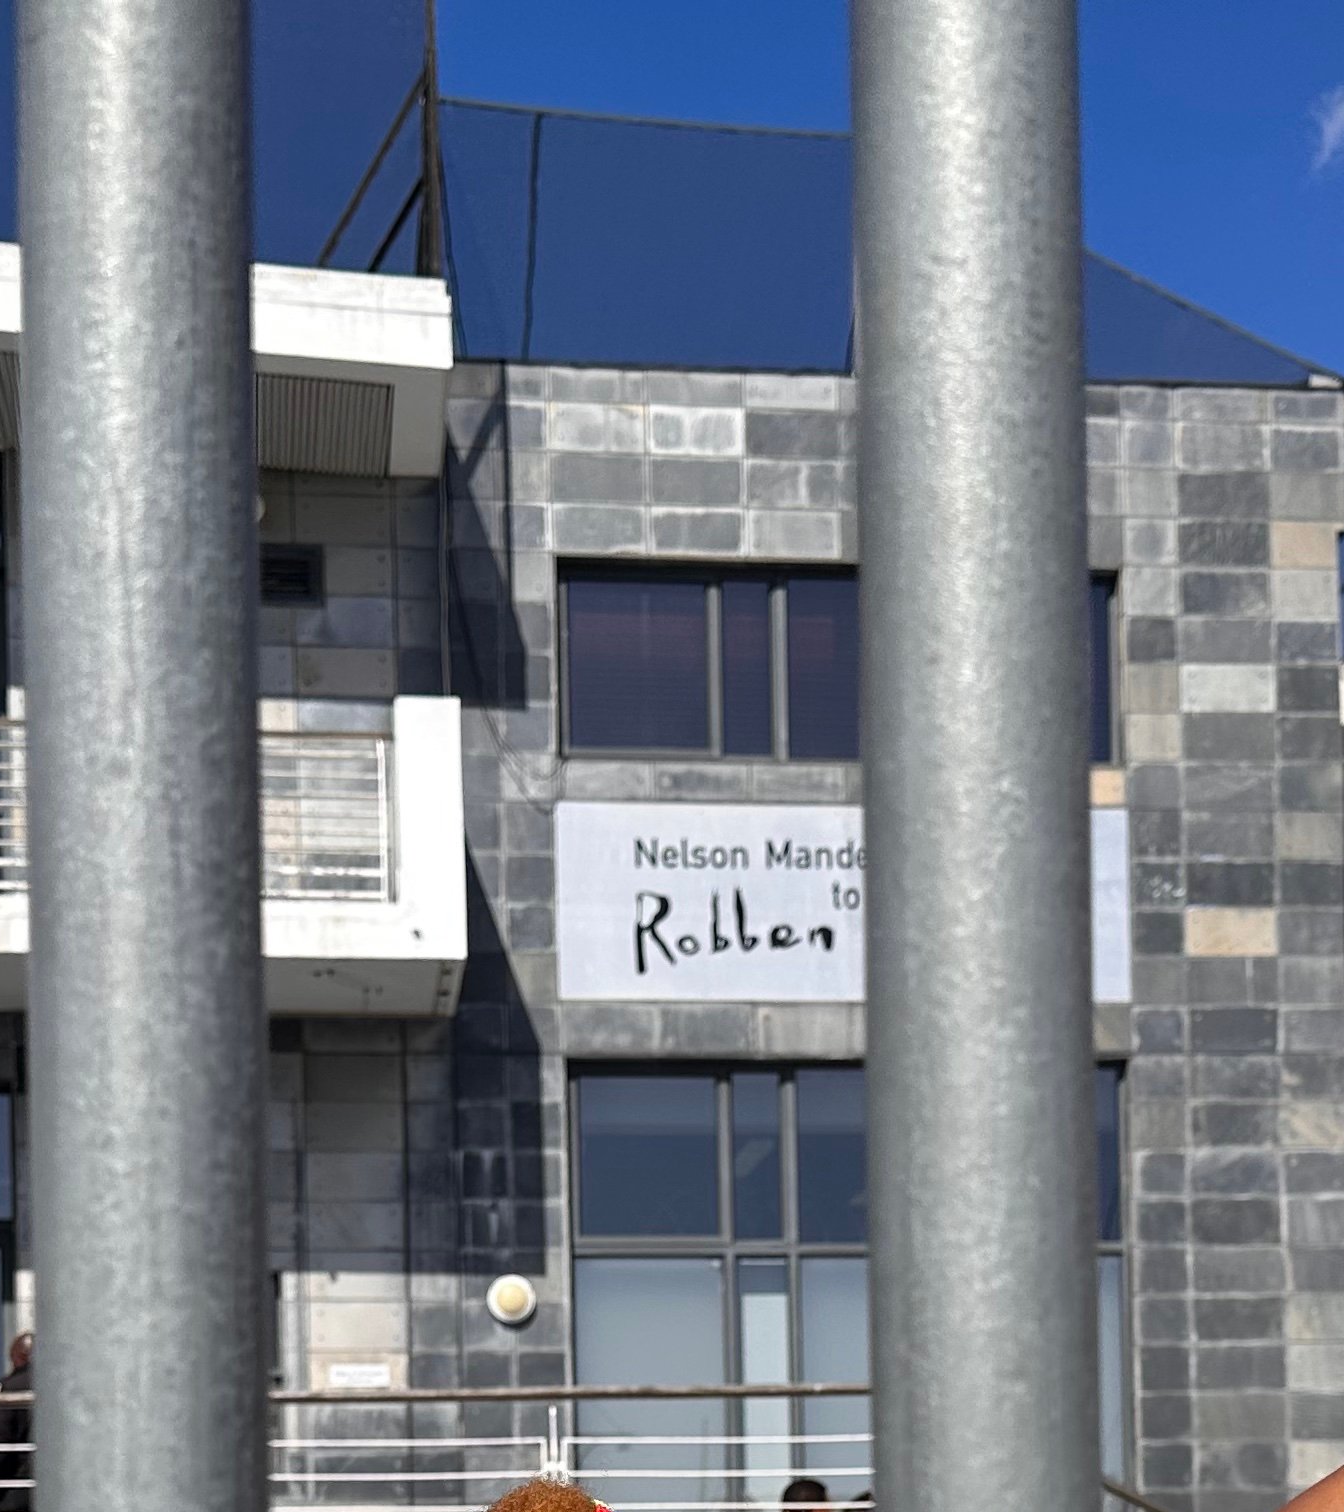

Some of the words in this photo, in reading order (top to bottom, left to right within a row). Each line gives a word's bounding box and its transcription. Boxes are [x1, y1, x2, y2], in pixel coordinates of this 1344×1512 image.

[633, 837, 750, 870] Nelson
[831, 880, 861, 911] to
[634, 886, 837, 976] Robben
